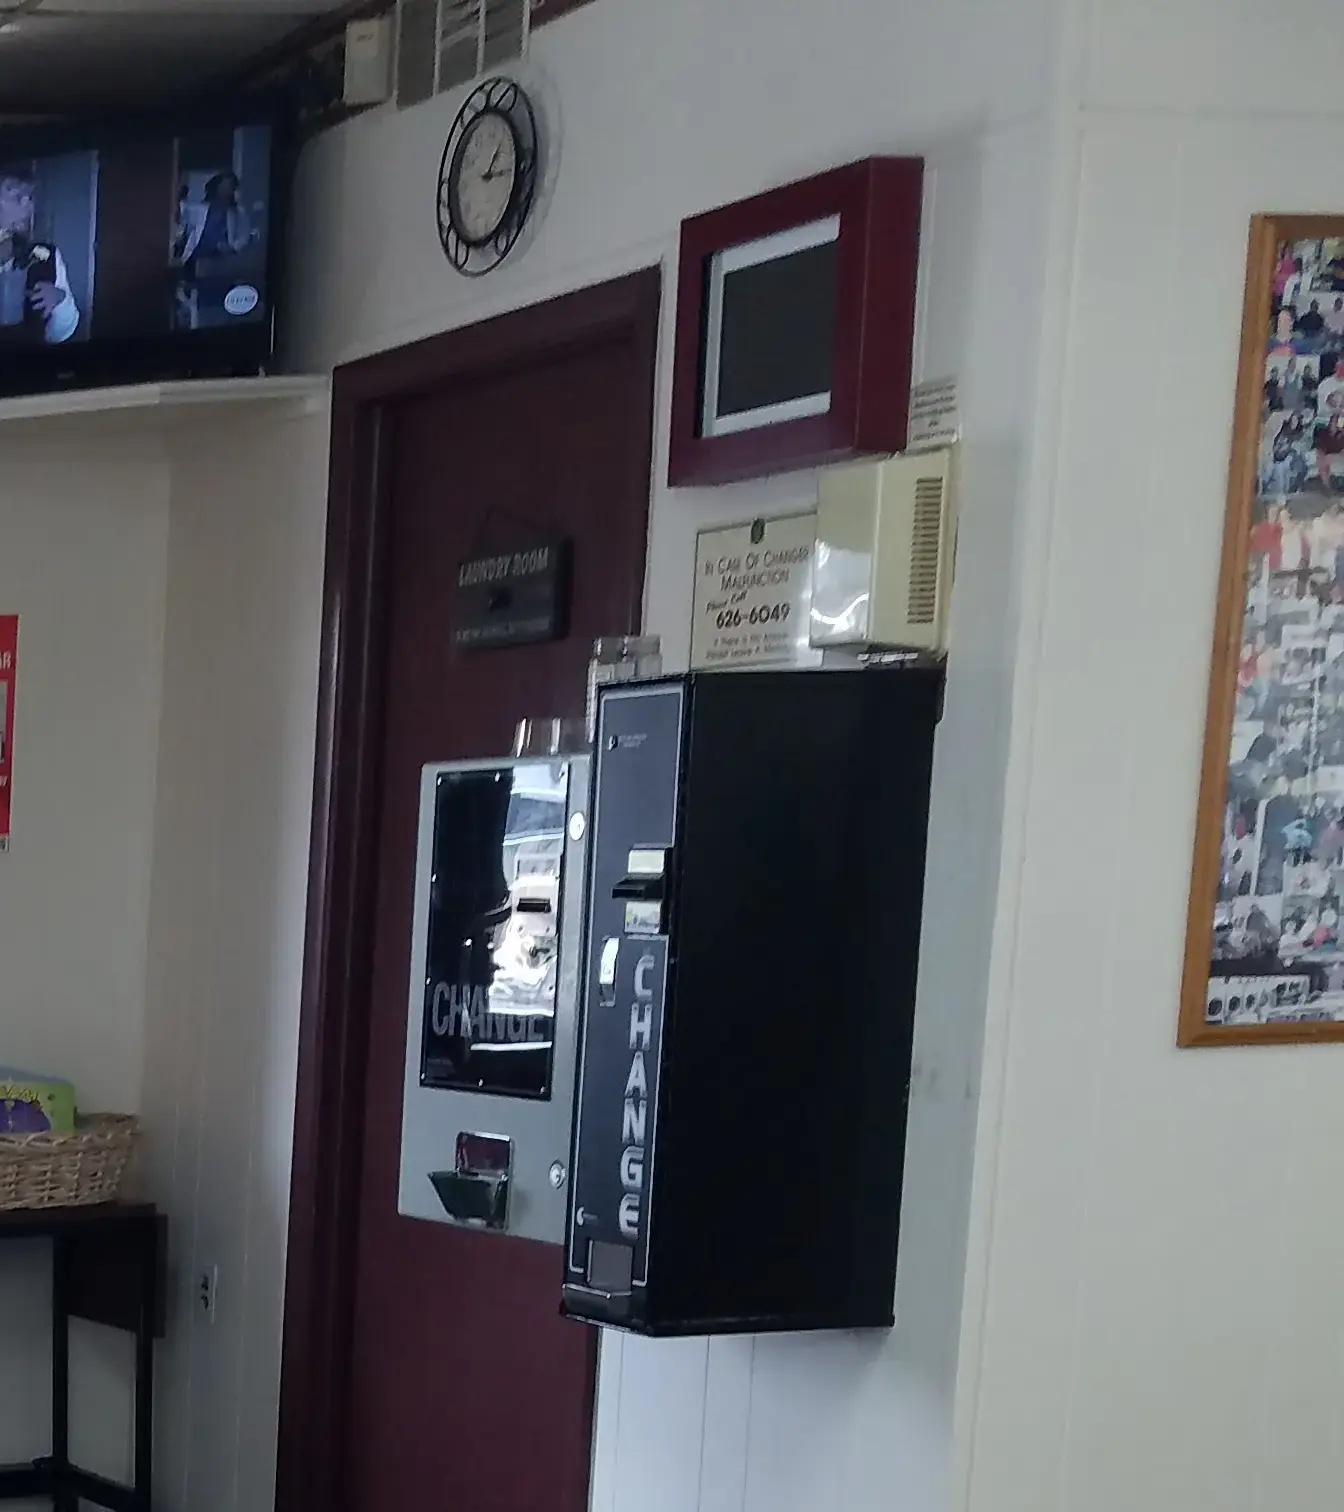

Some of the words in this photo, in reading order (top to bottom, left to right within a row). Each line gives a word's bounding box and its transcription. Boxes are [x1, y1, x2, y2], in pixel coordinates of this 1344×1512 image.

[458, 555, 511, 587] LAUNDRY
[512, 546, 549, 576] ROOM
[745, 552, 760, 570] OF
[716, 601, 791, 629] 626-6049
[432, 981, 545, 1042] CHANGE
[618, 954, 655, 1241] CHANGE
